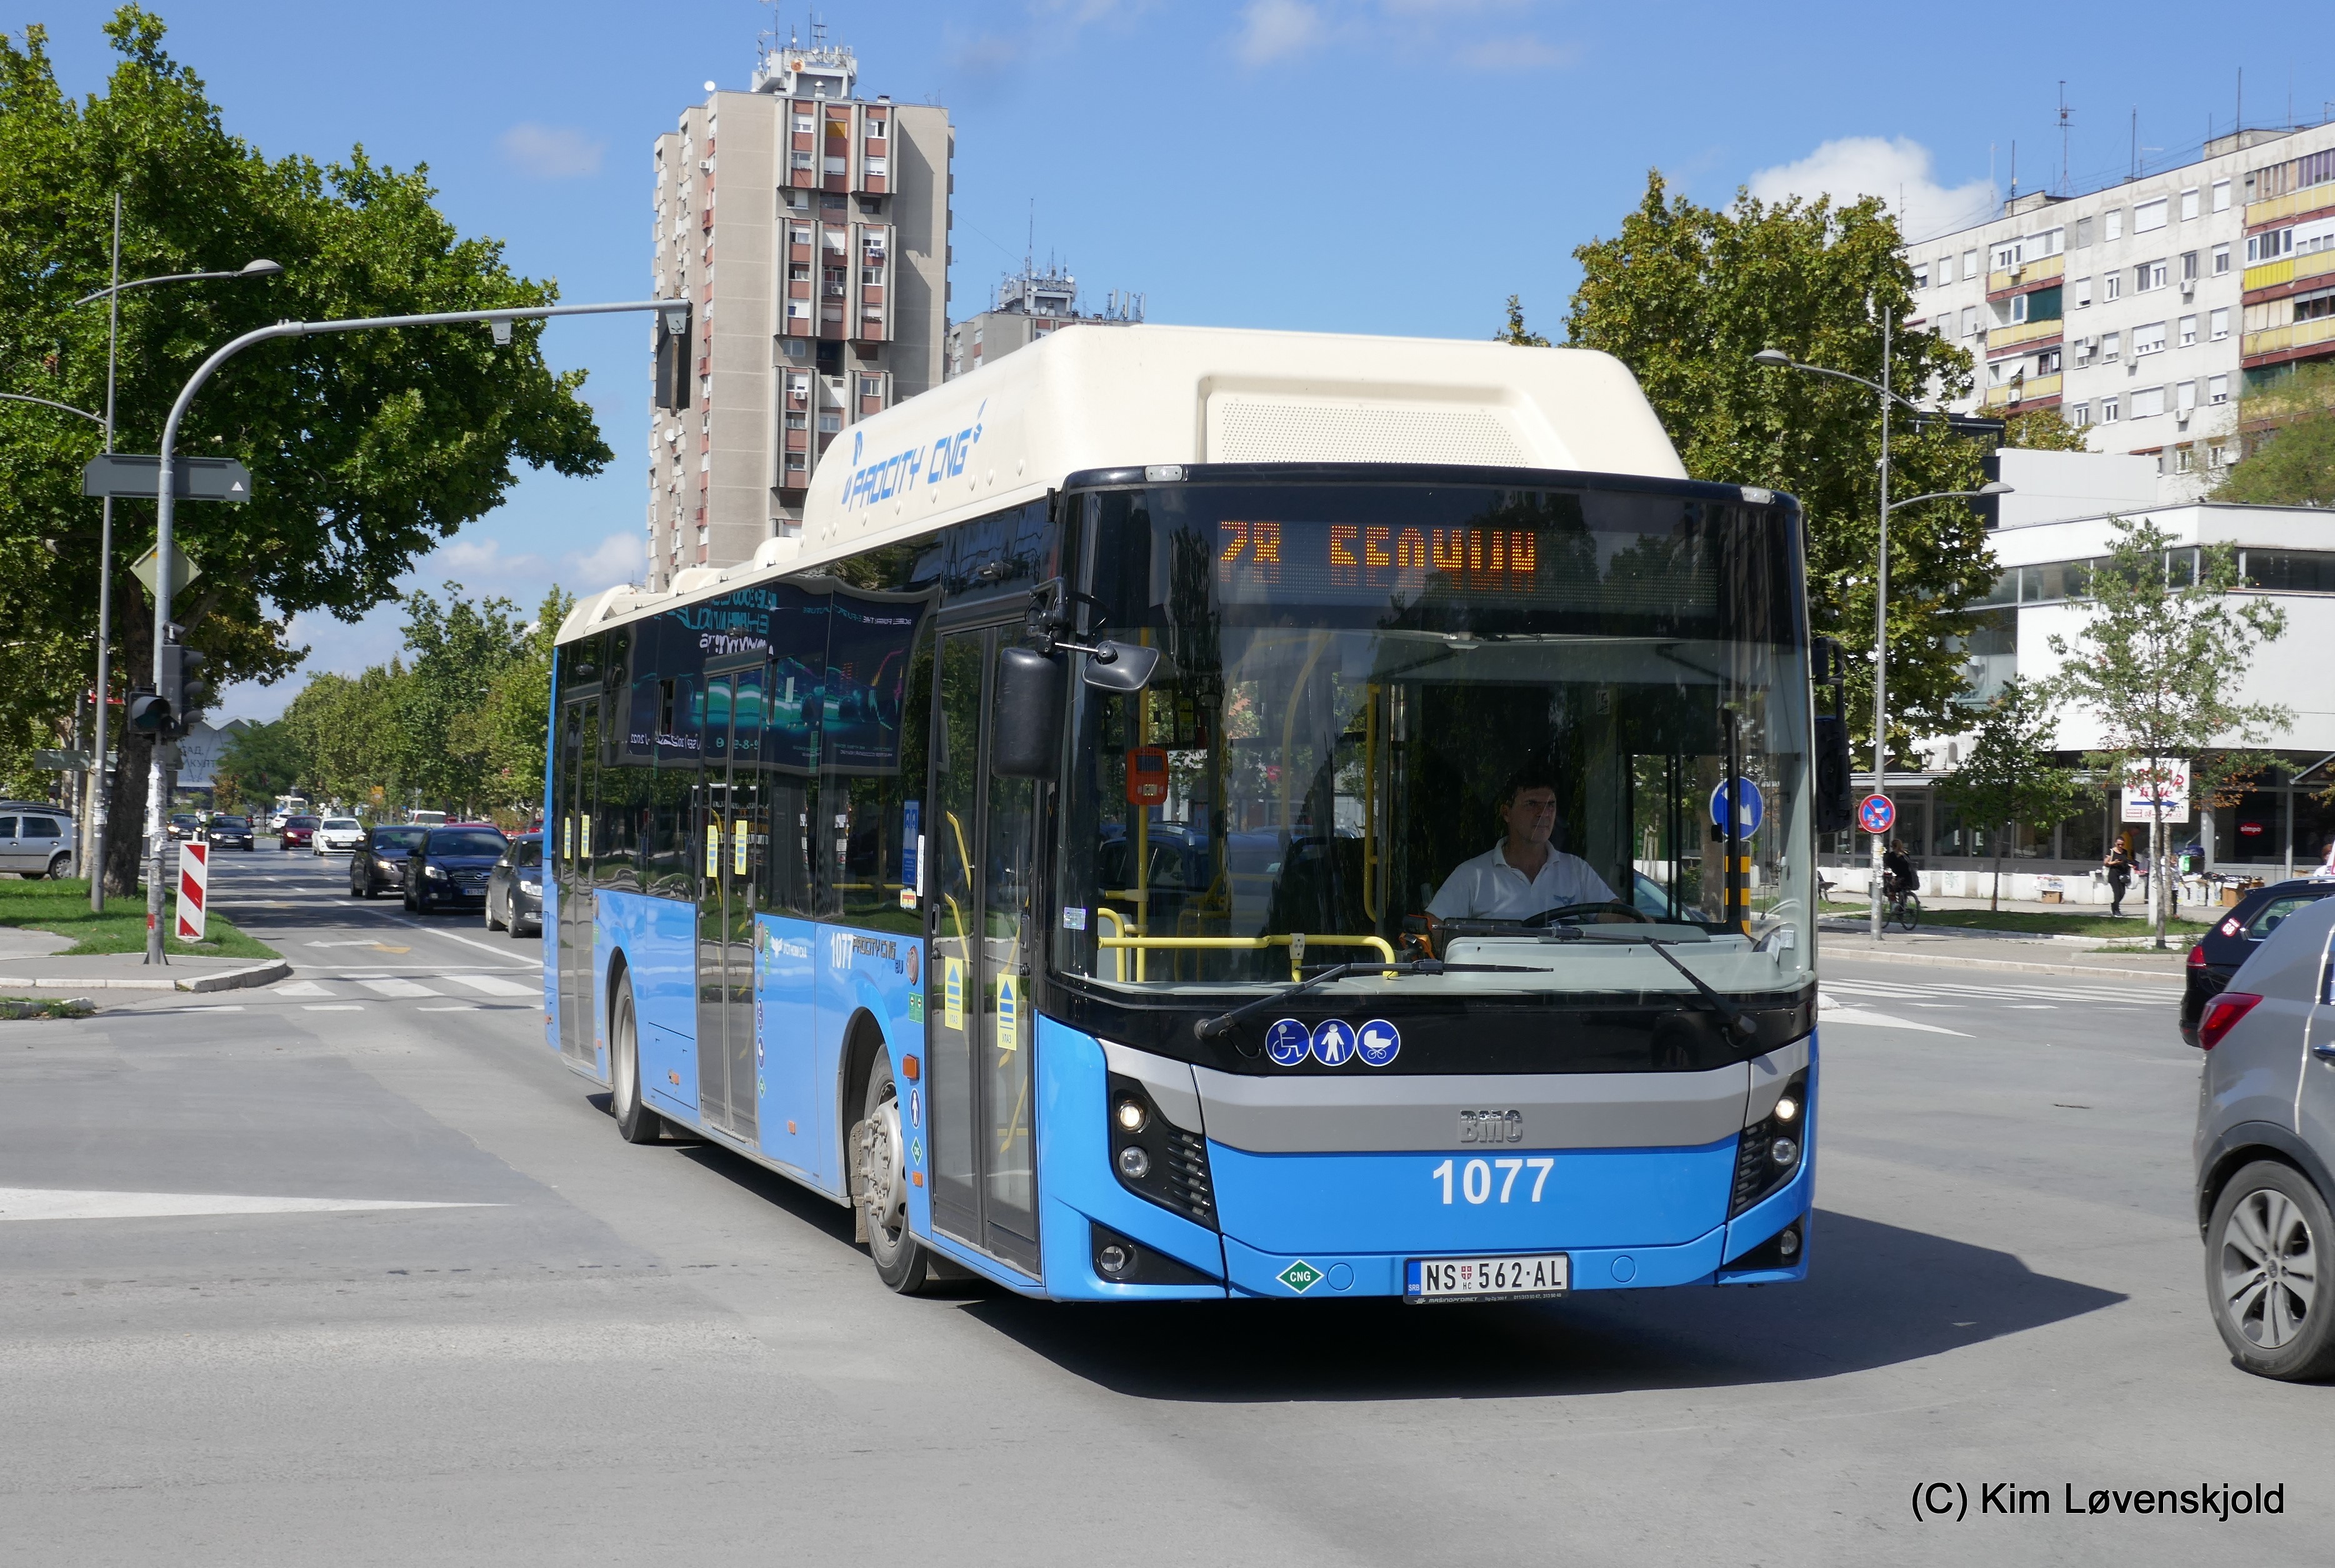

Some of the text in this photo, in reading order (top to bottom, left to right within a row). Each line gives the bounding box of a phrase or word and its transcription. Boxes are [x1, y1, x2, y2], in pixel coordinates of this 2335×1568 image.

[928, 427, 973, 484] CNG
[831, 932, 854, 970] 1077
[880, 939, 897, 961] CNG
[1002, 1032, 1012, 1044] УЛАЗ
[1460, 1109, 1523, 1143] BMC
[1432, 1157, 1554, 1204] 1077
[1289, 1271, 1311, 1282] CNG
[1408, 1283, 1420, 1292] SRB
[1426, 1264, 1456, 1291] NS
